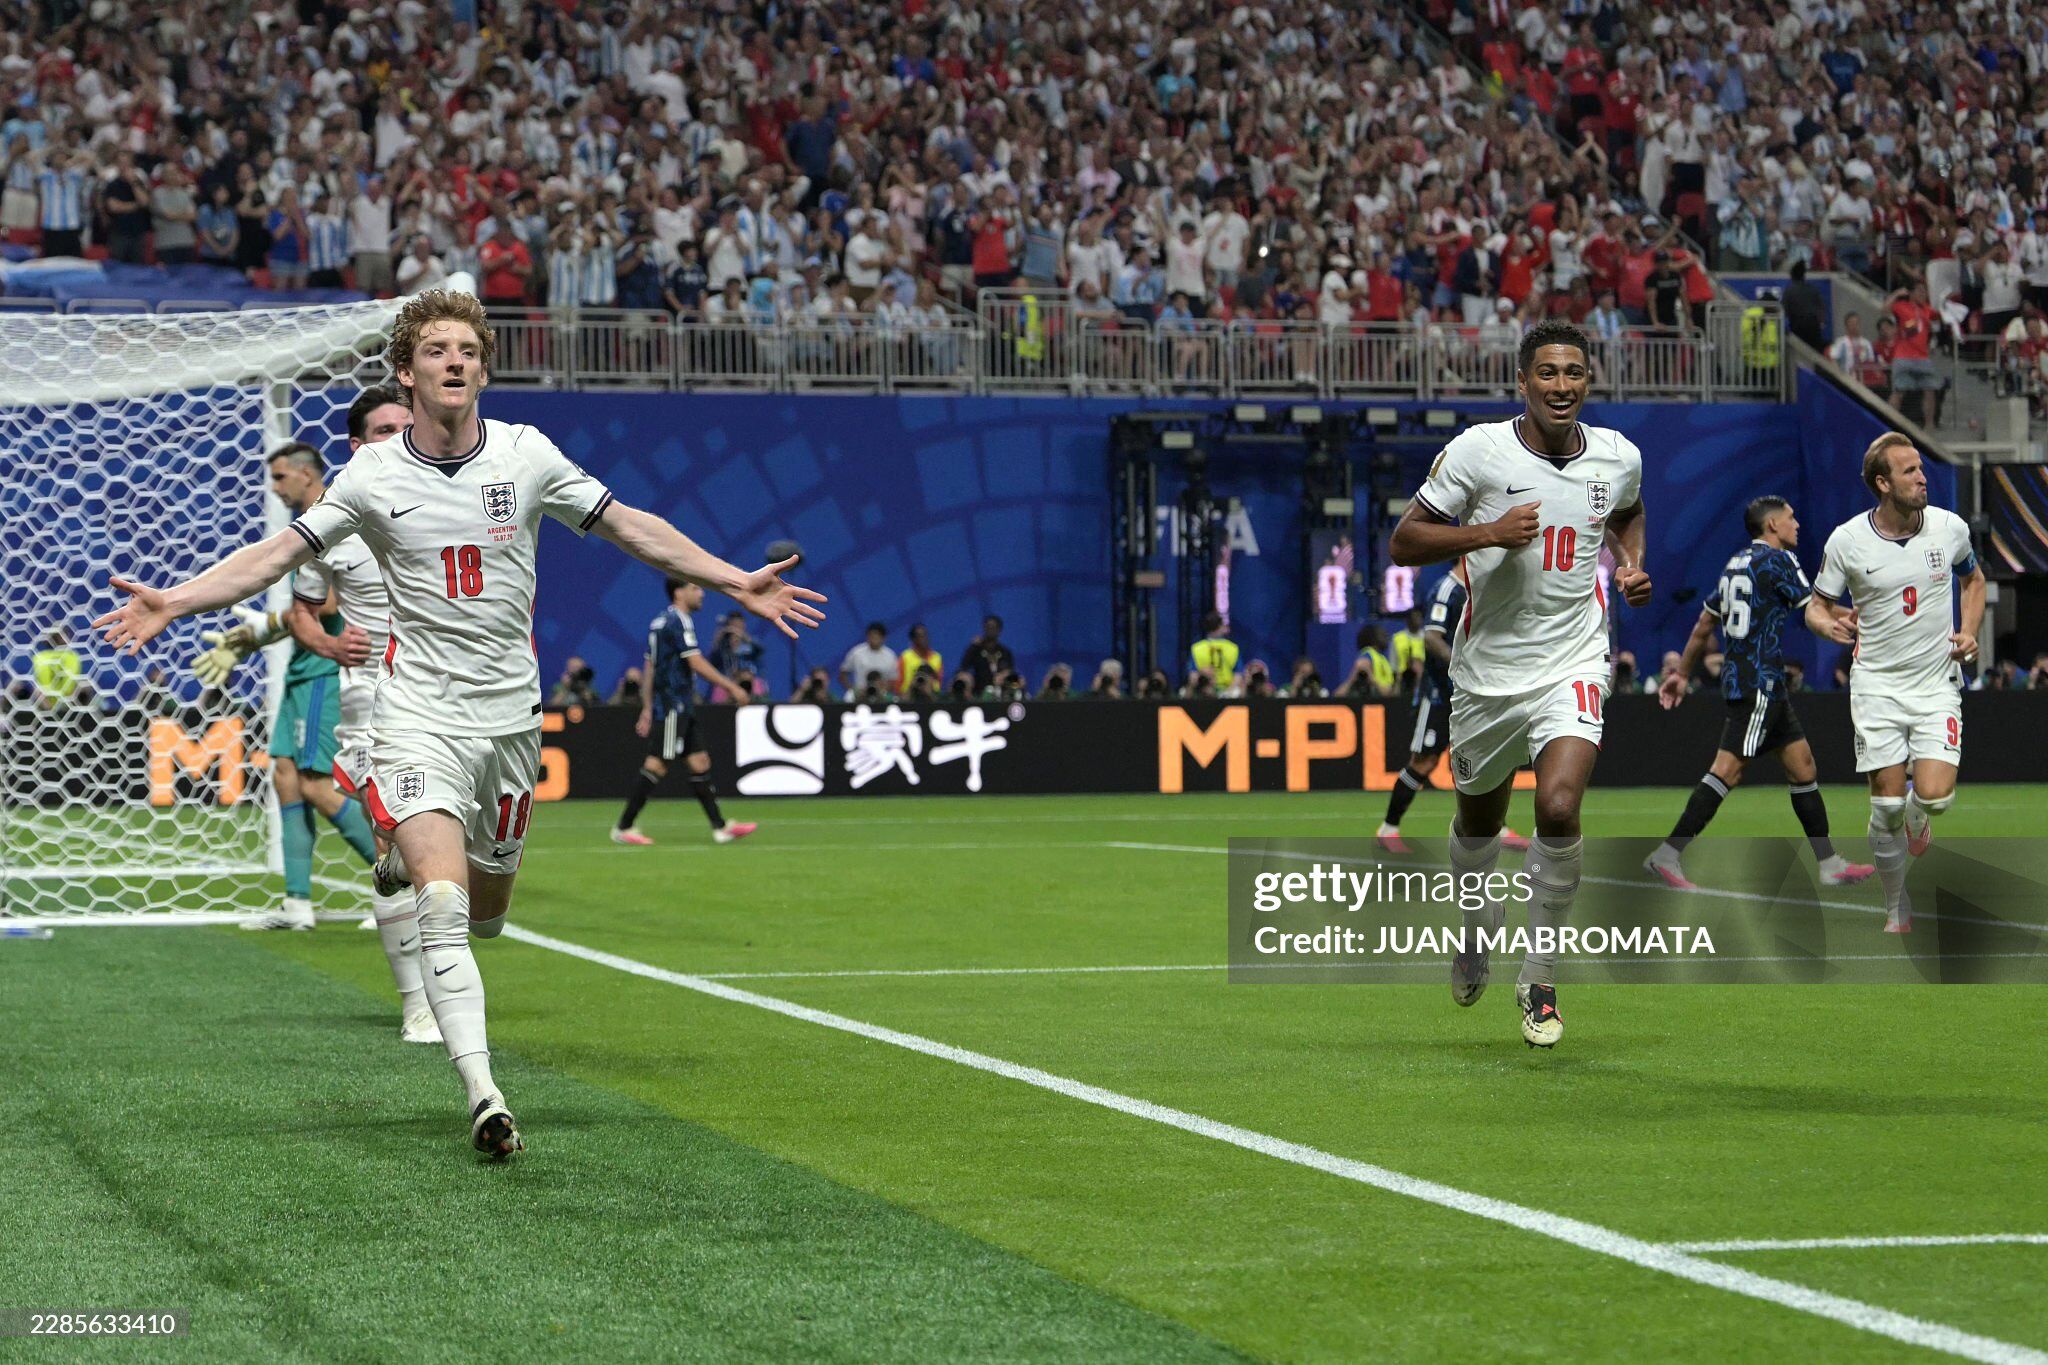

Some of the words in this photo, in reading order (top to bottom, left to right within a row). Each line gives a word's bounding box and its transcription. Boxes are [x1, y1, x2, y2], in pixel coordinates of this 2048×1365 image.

[487, 524, 518, 535] ARGENTINA
[1136, 504, 1260, 557] FIA
[1542, 525, 1577, 572] 10
[440, 544, 484, 599] 18
[1902, 586, 1918, 616] 9
[1571, 680, 1601, 721] 10
[840, 704, 1011, 793] 蒙牛
[1946, 716, 1960, 746] 9
[495, 790, 531, 842] 18
